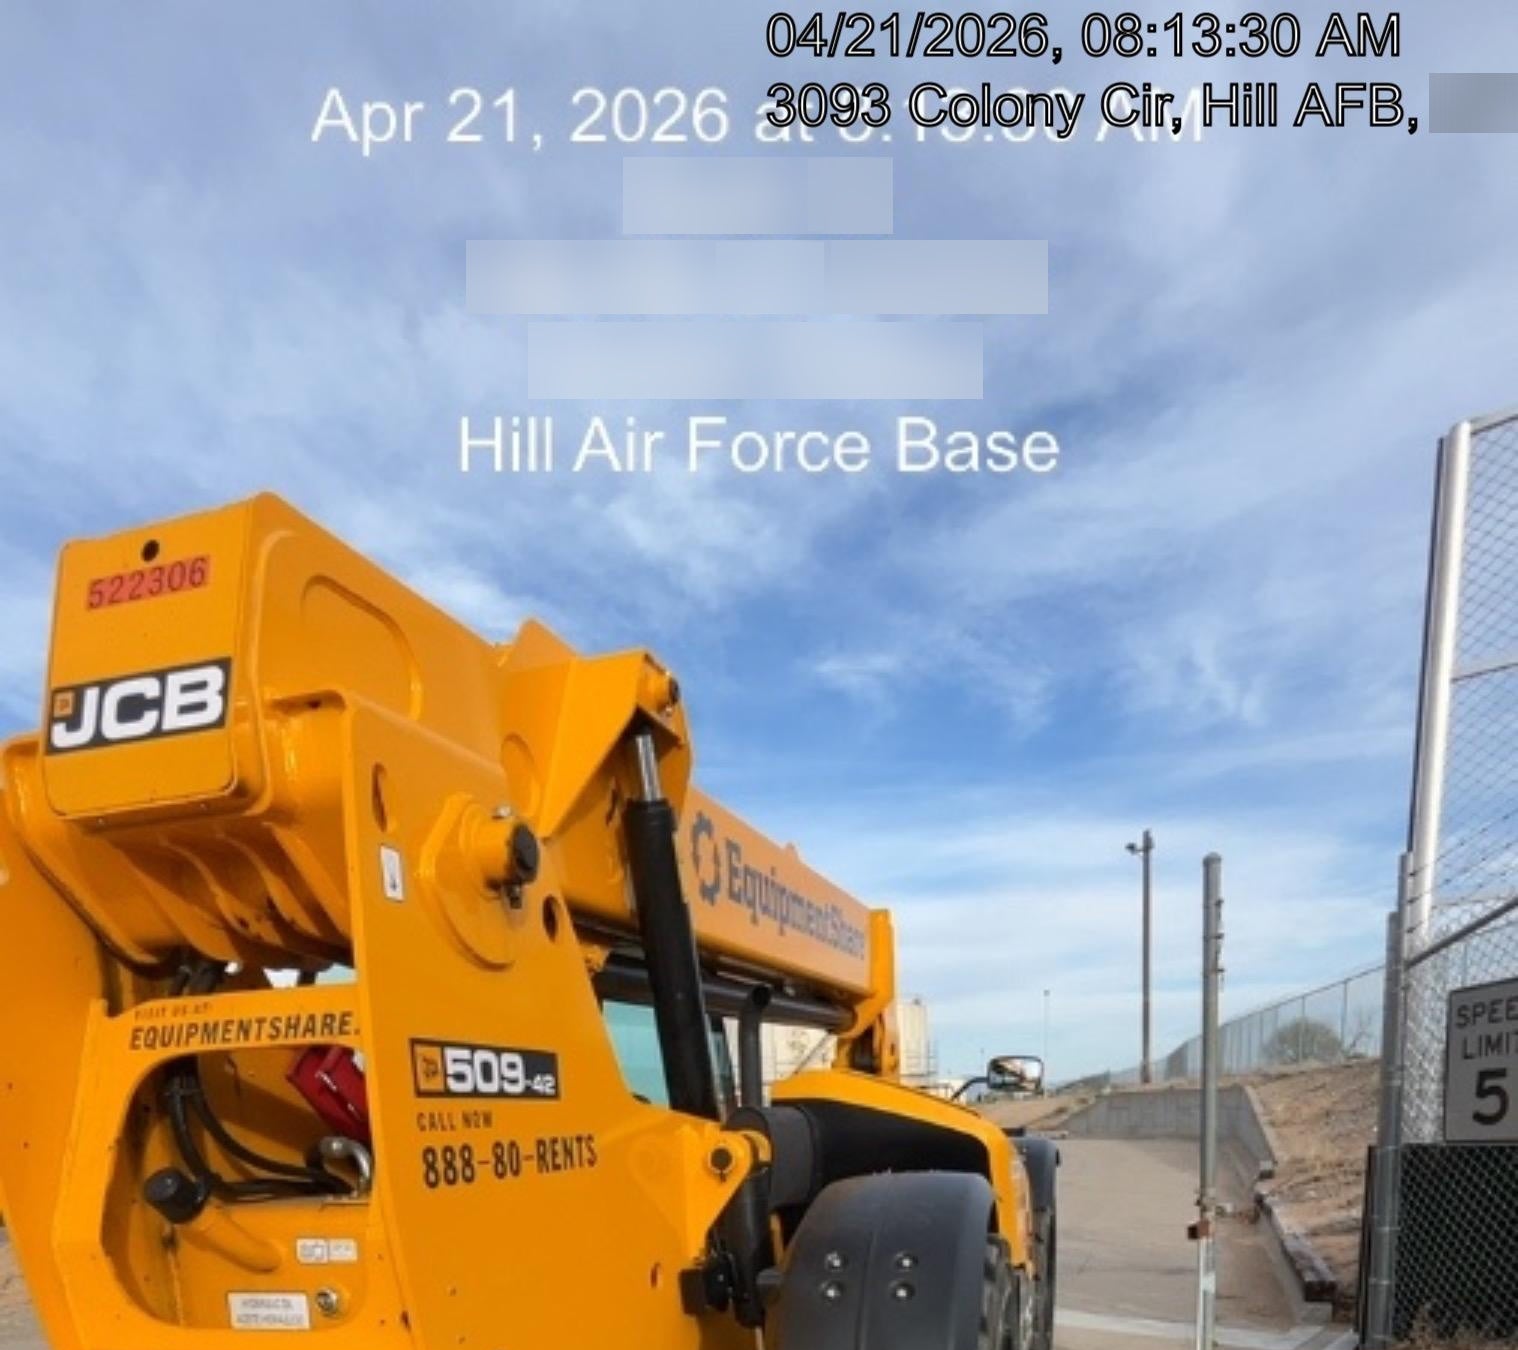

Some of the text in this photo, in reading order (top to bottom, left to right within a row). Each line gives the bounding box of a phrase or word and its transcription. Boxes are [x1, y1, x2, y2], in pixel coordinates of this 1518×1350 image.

[87, 556, 208, 610] 522306
[51, 665, 225, 749] JCB
[443, 1046, 557, 1096] 509-42
[1463, 1031, 1518, 1060] LIMI
[416, 1109, 493, 1132] CALL NOW
[1472, 1067, 1510, 1126] 5
[422, 1133, 598, 1189] 888-80-RENTS
